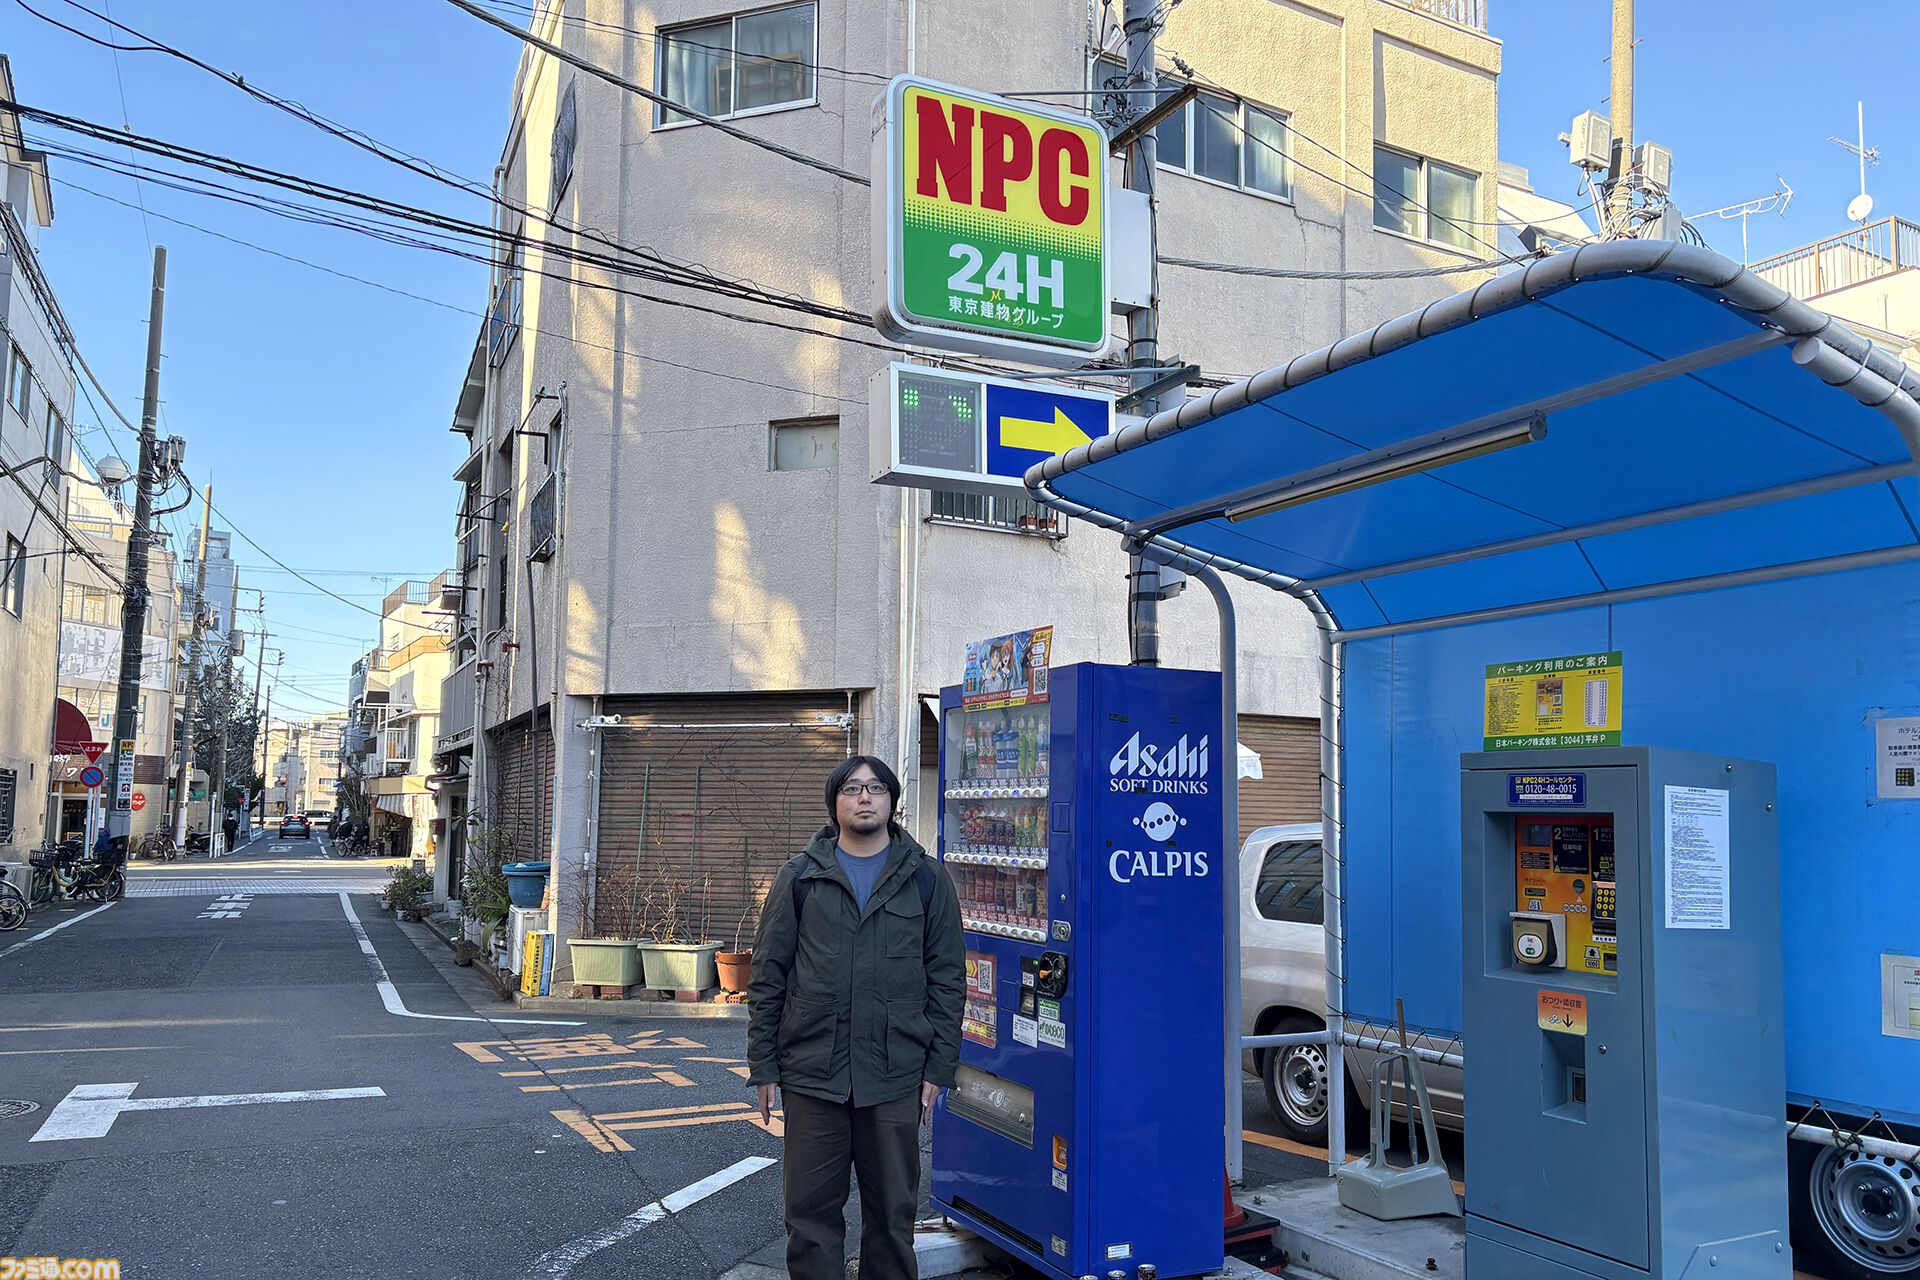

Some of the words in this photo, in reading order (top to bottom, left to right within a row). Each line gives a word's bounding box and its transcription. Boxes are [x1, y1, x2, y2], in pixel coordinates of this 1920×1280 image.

[916, 96, 1090, 226] NPC
[947, 243, 1065, 309] 24H
[948, 295, 1065, 329] 東京建物グループ
[1497, 655, 1608, 675] パーキング利用のご案内
[1109, 730, 1208, 779] Asahi
[1495, 737, 1558, 748] 日本パーキング株式会社
[1109, 778, 1149, 793] SOFT
[1152, 779, 1208, 795] DRINKS
[1525, 784, 1577, 794] 0120-48-0015
[1554, 827, 1562, 840] 2
[1108, 849, 1209, 883] CALPIS
